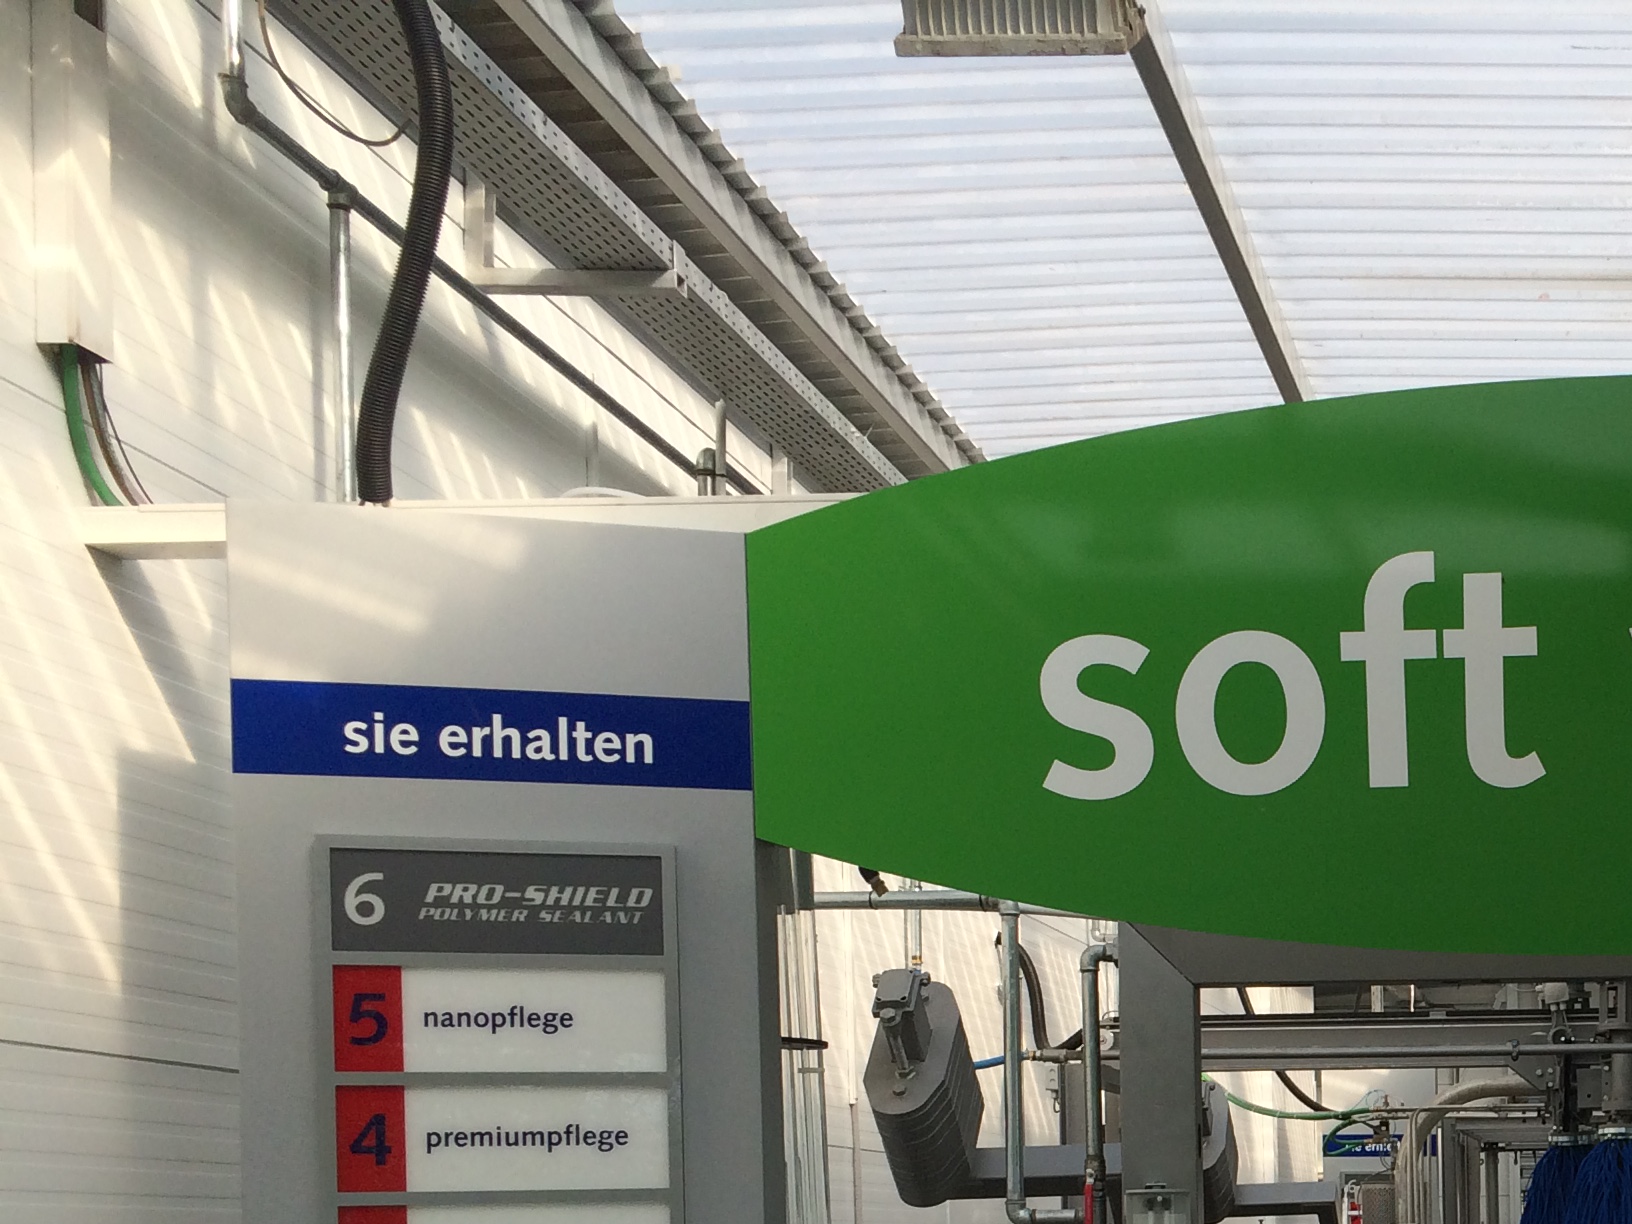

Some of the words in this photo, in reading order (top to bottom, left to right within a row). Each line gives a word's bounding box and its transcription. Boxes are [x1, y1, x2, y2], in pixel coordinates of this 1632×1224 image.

[1039, 550, 1548, 802] soft
[343, 712, 420, 757] sie
[439, 714, 655, 766] erhalten
[343, 872, 385, 926] 6
[424, 883, 653, 908] PRO-SHIELD
[418, 907, 528, 924] POLYMER
[538, 909, 644, 925] SEALANT
[348, 993, 389, 1046] 5
[423, 1006, 574, 1035] nanopflege
[349, 1113, 392, 1166] 4
[426, 1124, 629, 1153] premiumpflege
